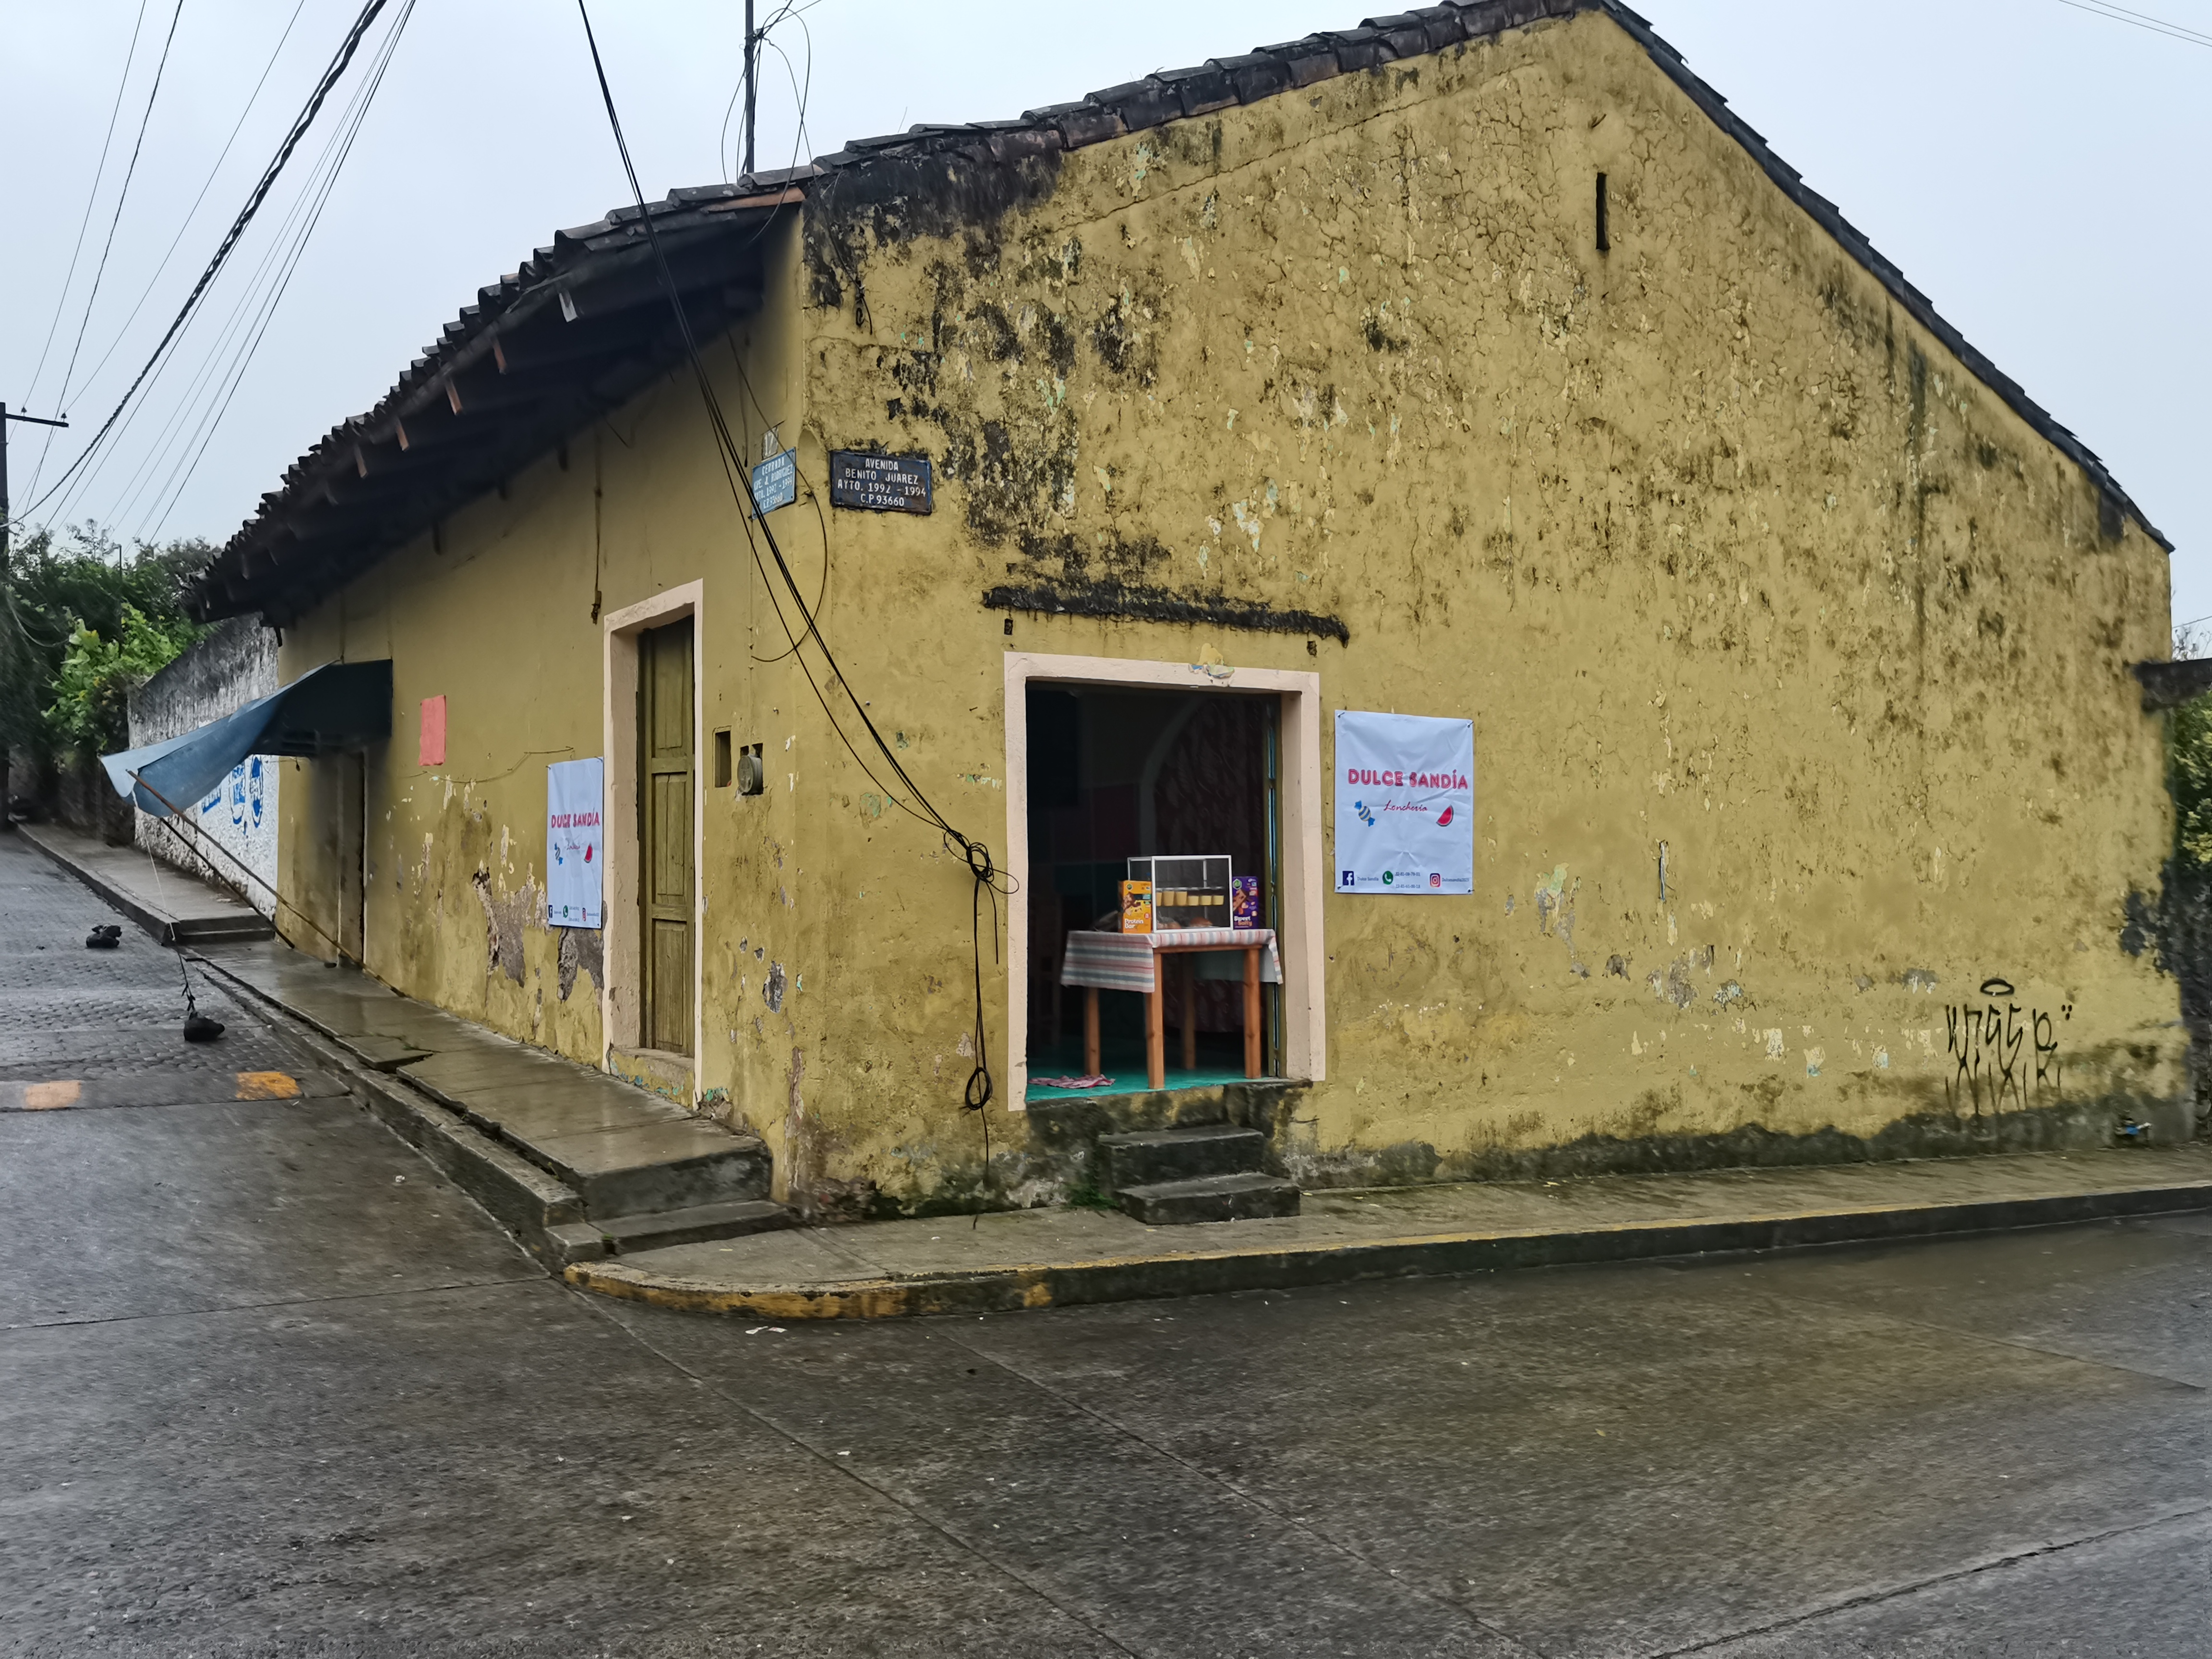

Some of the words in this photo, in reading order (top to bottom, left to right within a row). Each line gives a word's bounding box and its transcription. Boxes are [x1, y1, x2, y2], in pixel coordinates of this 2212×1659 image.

[762, 457, 785, 476] CERRADA
[865, 458, 899, 471] AVENIDA
[845, 468, 877, 481] BENITO
[885, 473, 918, 485] JUAREZ
[838, 479, 864, 491] AYTO.
[868, 482, 891, 494] 1992
[904, 486, 926, 497] 1994
[1348, 769, 1404, 786] DULCE
[1409, 769, 1468, 789] SANDÍA
